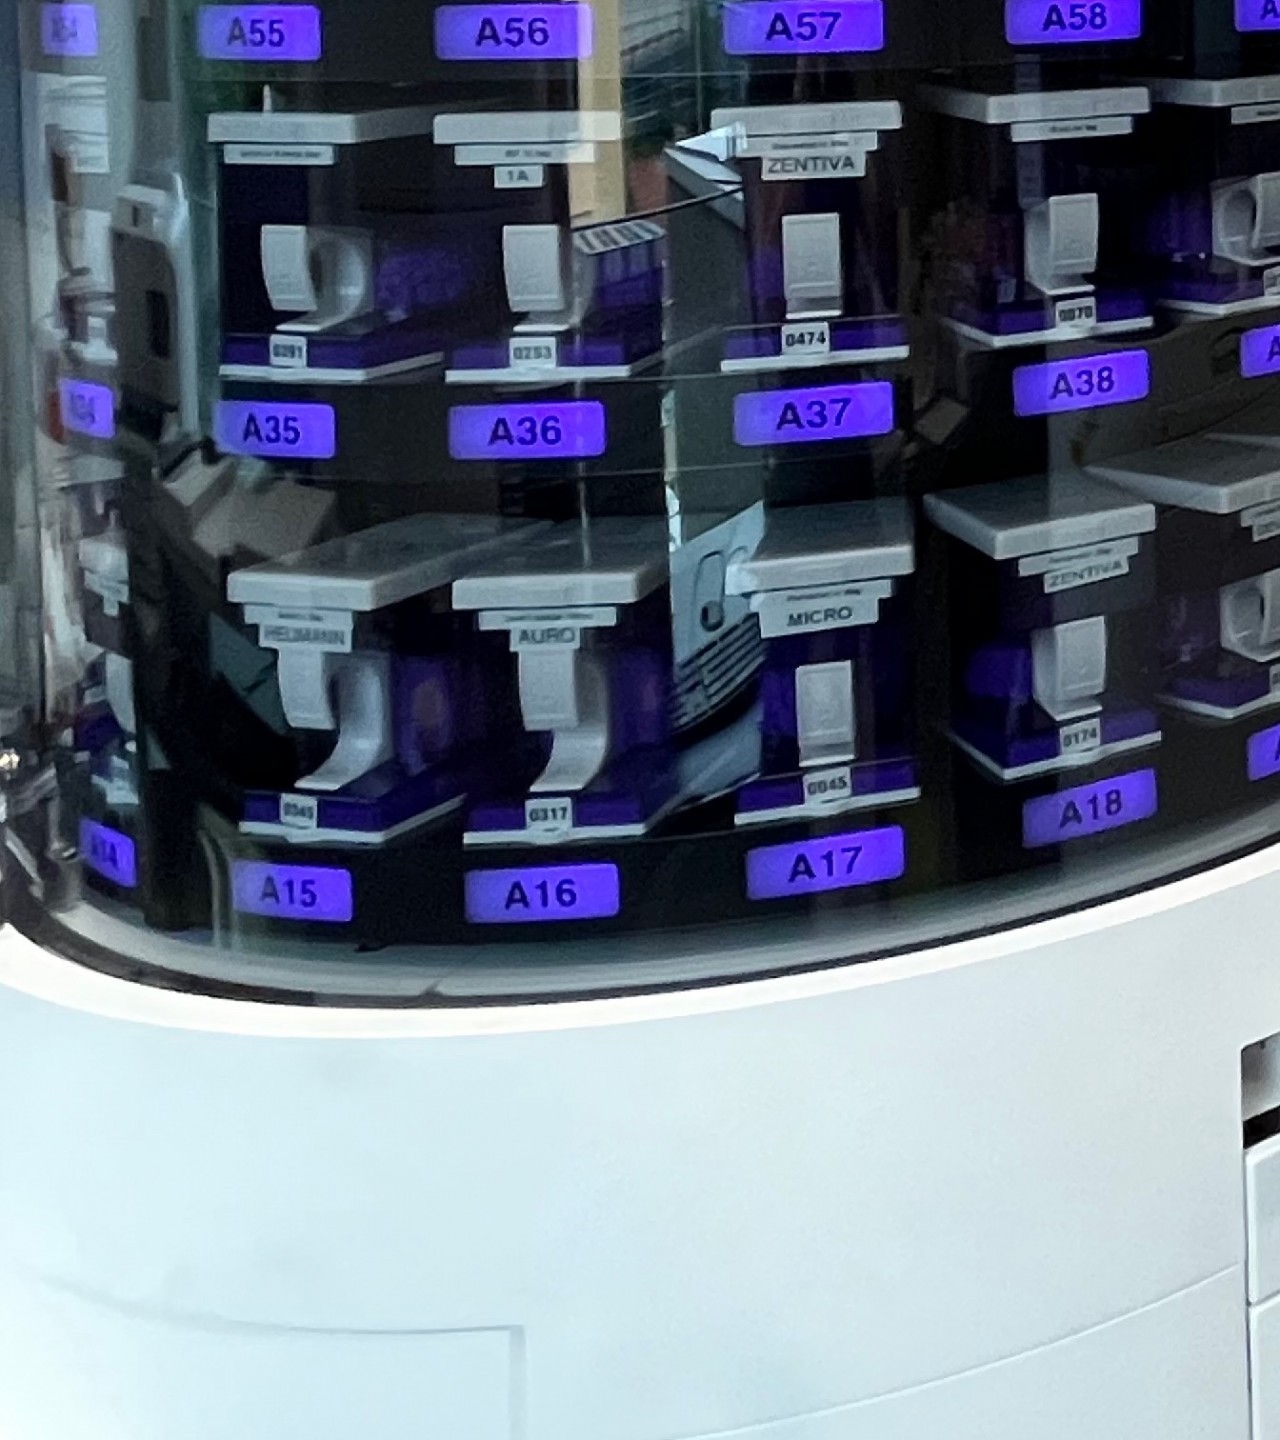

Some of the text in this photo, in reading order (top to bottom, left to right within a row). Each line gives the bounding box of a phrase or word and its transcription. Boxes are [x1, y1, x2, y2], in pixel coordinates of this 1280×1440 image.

[227, 17, 284, 47] A55
[766, 12, 841, 41] A57
[1042, 3, 1106, 32] A58
[475, 18, 549, 47] A56
[508, 170, 529, 181] 1A
[768, 156, 854, 173] ZENTIVA
[786, 331, 826, 347] 0474
[1048, 366, 1114, 400] A38
[243, 413, 300, 444] A35
[776, 398, 851, 430] A37
[488, 416, 561, 445] A36
[1049, 560, 1123, 590] ZENTIVA
[787, 606, 852, 626] MICRO
[519, 627, 575, 644] AURO
[1063, 727, 1098, 747] 0174
[806, 776, 848, 796] 0045
[529, 806, 567, 822] 0317
[1058, 790, 1122, 830] A18
[788, 846, 862, 883] A17
[260, 876, 317, 907] A15
[504, 879, 576, 910] A16
